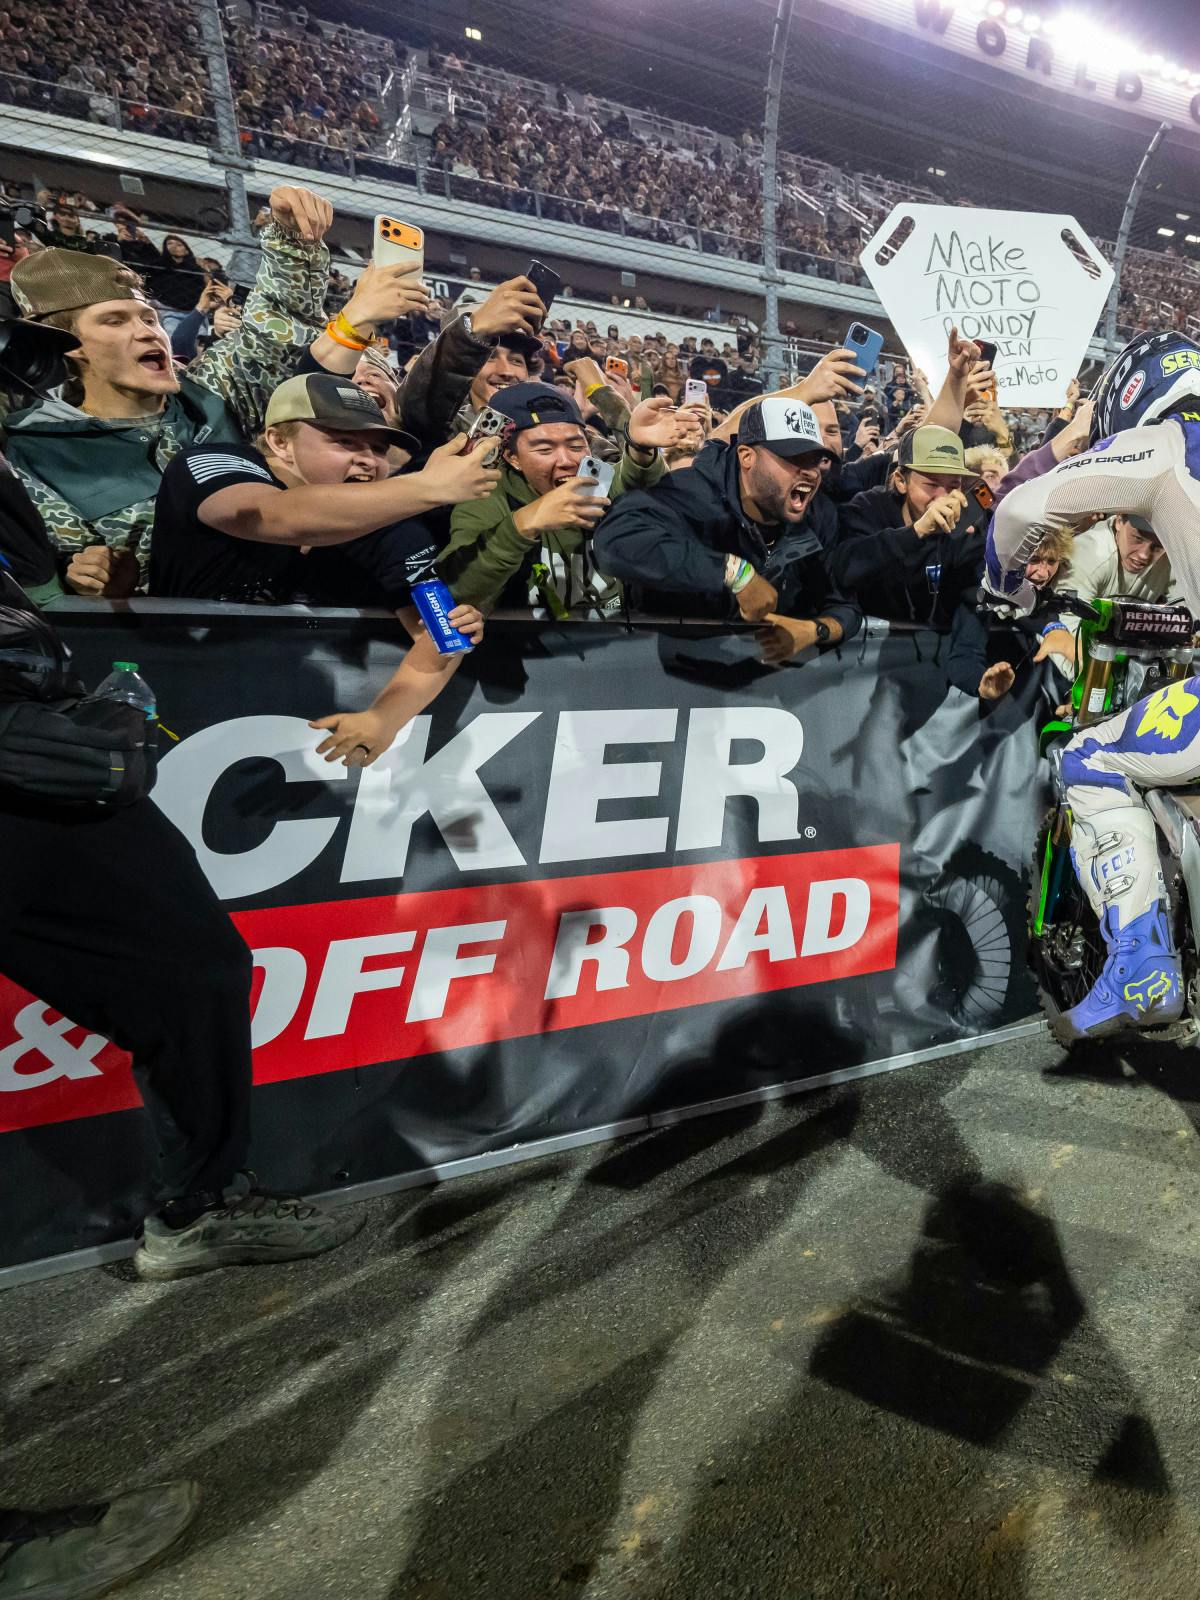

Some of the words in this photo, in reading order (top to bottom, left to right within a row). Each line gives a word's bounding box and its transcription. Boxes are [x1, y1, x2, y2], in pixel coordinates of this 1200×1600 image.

[914, 0, 1143, 101] WORLD
[926, 230, 1027, 274] Make
[936, 273, 1041, 312] MOTO
[1122, 376, 1143, 405] BELL
[1056, 458, 1093, 474] PRO
[1095, 449, 1155, 464] CIRCUIT
[425, 591, 444, 617] LIGHT
[1125, 611, 1190, 623] RENTHAL
[438, 616, 453, 636] BUD
[1124, 621, 1189, 634] RENTHAL
[148, 705, 804, 900] CKER
[1101, 847, 1136, 879] FOX
[251, 920, 507, 1050] OFF
[543, 877, 871, 1001] ROAD
